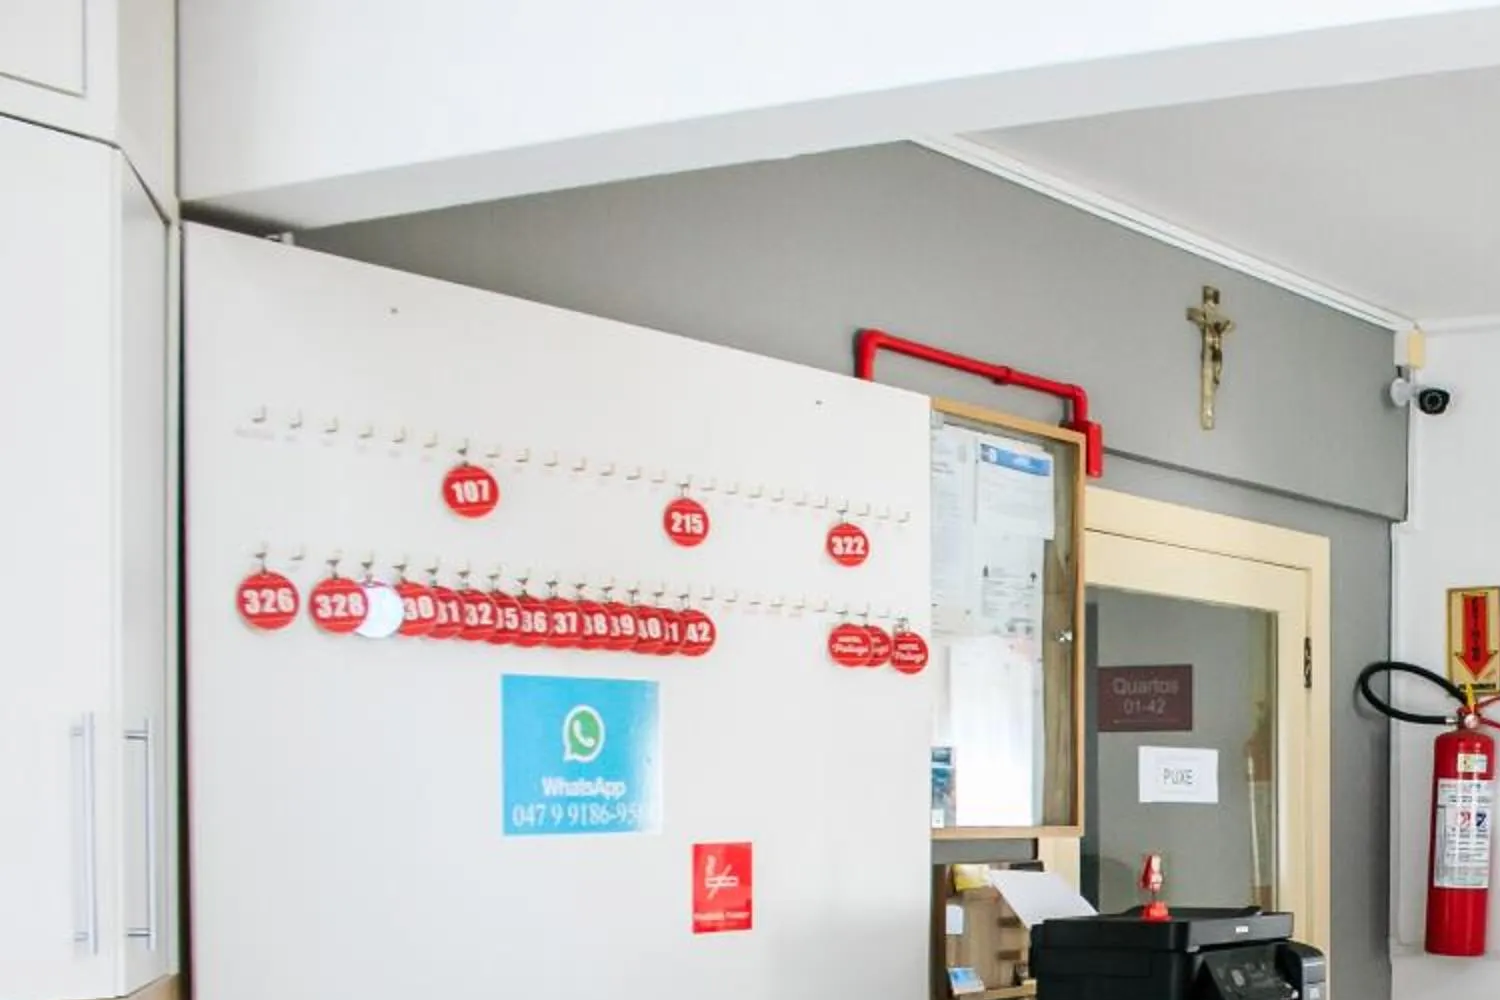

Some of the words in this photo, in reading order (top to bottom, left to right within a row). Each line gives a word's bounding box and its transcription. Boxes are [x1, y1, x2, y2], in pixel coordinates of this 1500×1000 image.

[451, 480, 490, 503] 107
[671, 511, 704, 534] 215
[830, 535, 866, 556] 322
[242, 588, 296, 615] 326
[315, 592, 365, 618] 328
[463, 602, 494, 627] 32
[521, 611, 548, 633] 36
[553, 611, 578, 635] 37
[686, 622, 712, 643] 42
[1112, 677, 1180, 696] Quartos
[1122, 698, 1167, 715] 01-42
[1163, 767, 1193, 785] PUXE
[541, 776, 627, 800] WhatsApp
[511, 803, 547, 827] 047
[551, 803, 563, 827] 9
